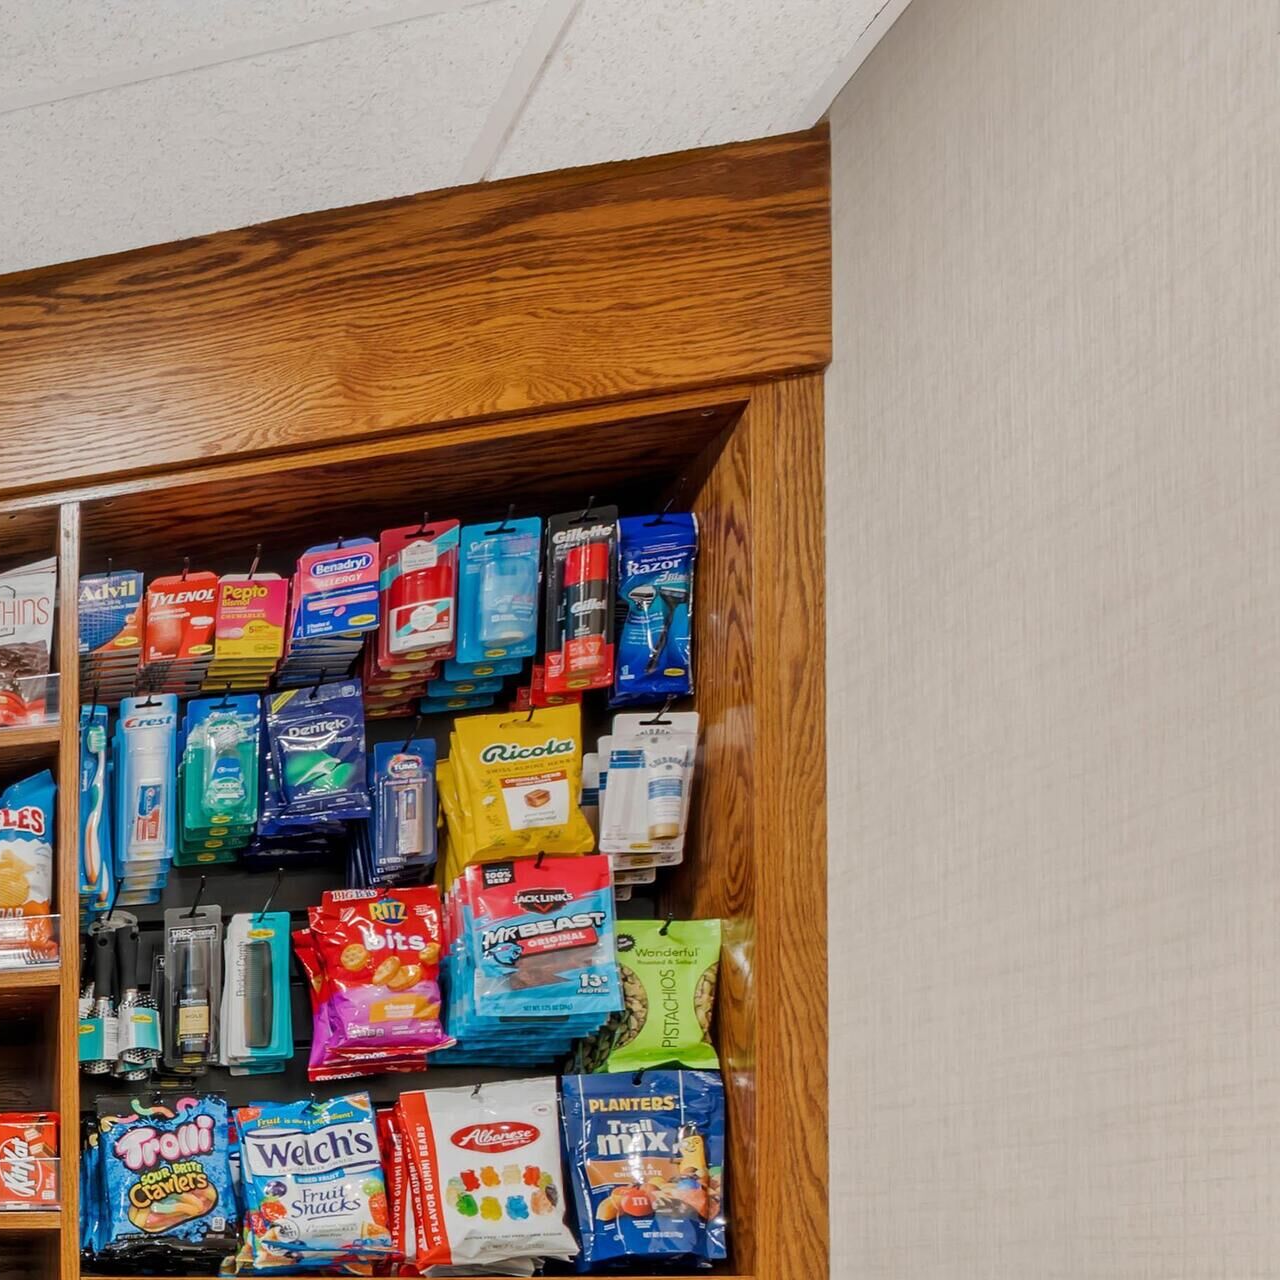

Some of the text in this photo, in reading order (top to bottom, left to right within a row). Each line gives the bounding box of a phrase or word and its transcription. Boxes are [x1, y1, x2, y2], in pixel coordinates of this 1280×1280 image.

[552, 523, 614, 545] Gillette
[315, 555, 368, 576] Benadryl
[626, 557, 683, 577] Razor
[319, 572, 363, 589] ALLERGY
[78, 579, 137, 603] Advil
[150, 588, 216, 609] TYLENOL
[222, 584, 269, 601] Pepto
[222, 598, 251, 607] Bismol
[124, 715, 175, 730] Crest
[288, 719, 347, 738] DenTek
[482, 738, 574, 765] Ricola
[393, 759, 418, 772] TUMS
[485, 871, 512, 880] 100%
[512, 890, 574, 905] JACK LINK'S
[368, 902, 409, 921] RITZ
[363, 928, 428, 952] bits
[526, 931, 587, 948] ORIGINAL
[634, 946, 698, 959] Wonderful
[577, 986, 610, 995] PROTEIN
[662, 968, 675, 1049] PISTACHIOS
[588, 1095, 676, 1113] PLANTERS
[256, 1116, 282, 1128] Fruit
[606, 1119, 653, 1133] Trail
[115, 1115, 215, 1172] Trolli
[459, 1126, 535, 1148] Albanese
[597, 1131, 668, 1156] mix
[253, 1129, 374, 1169] Welch's
[140, 1160, 204, 1187] SOUR BRITE
[419, 1125, 440, 1235] FLAVOR GUMMI BEARS
[128, 1172, 209, 1209] Crawlers
[302, 1185, 344, 1203] Fruit
[392, 1163, 402, 1236] FLAVOR GUMMI
[291, 1197, 362, 1221] Snacks
